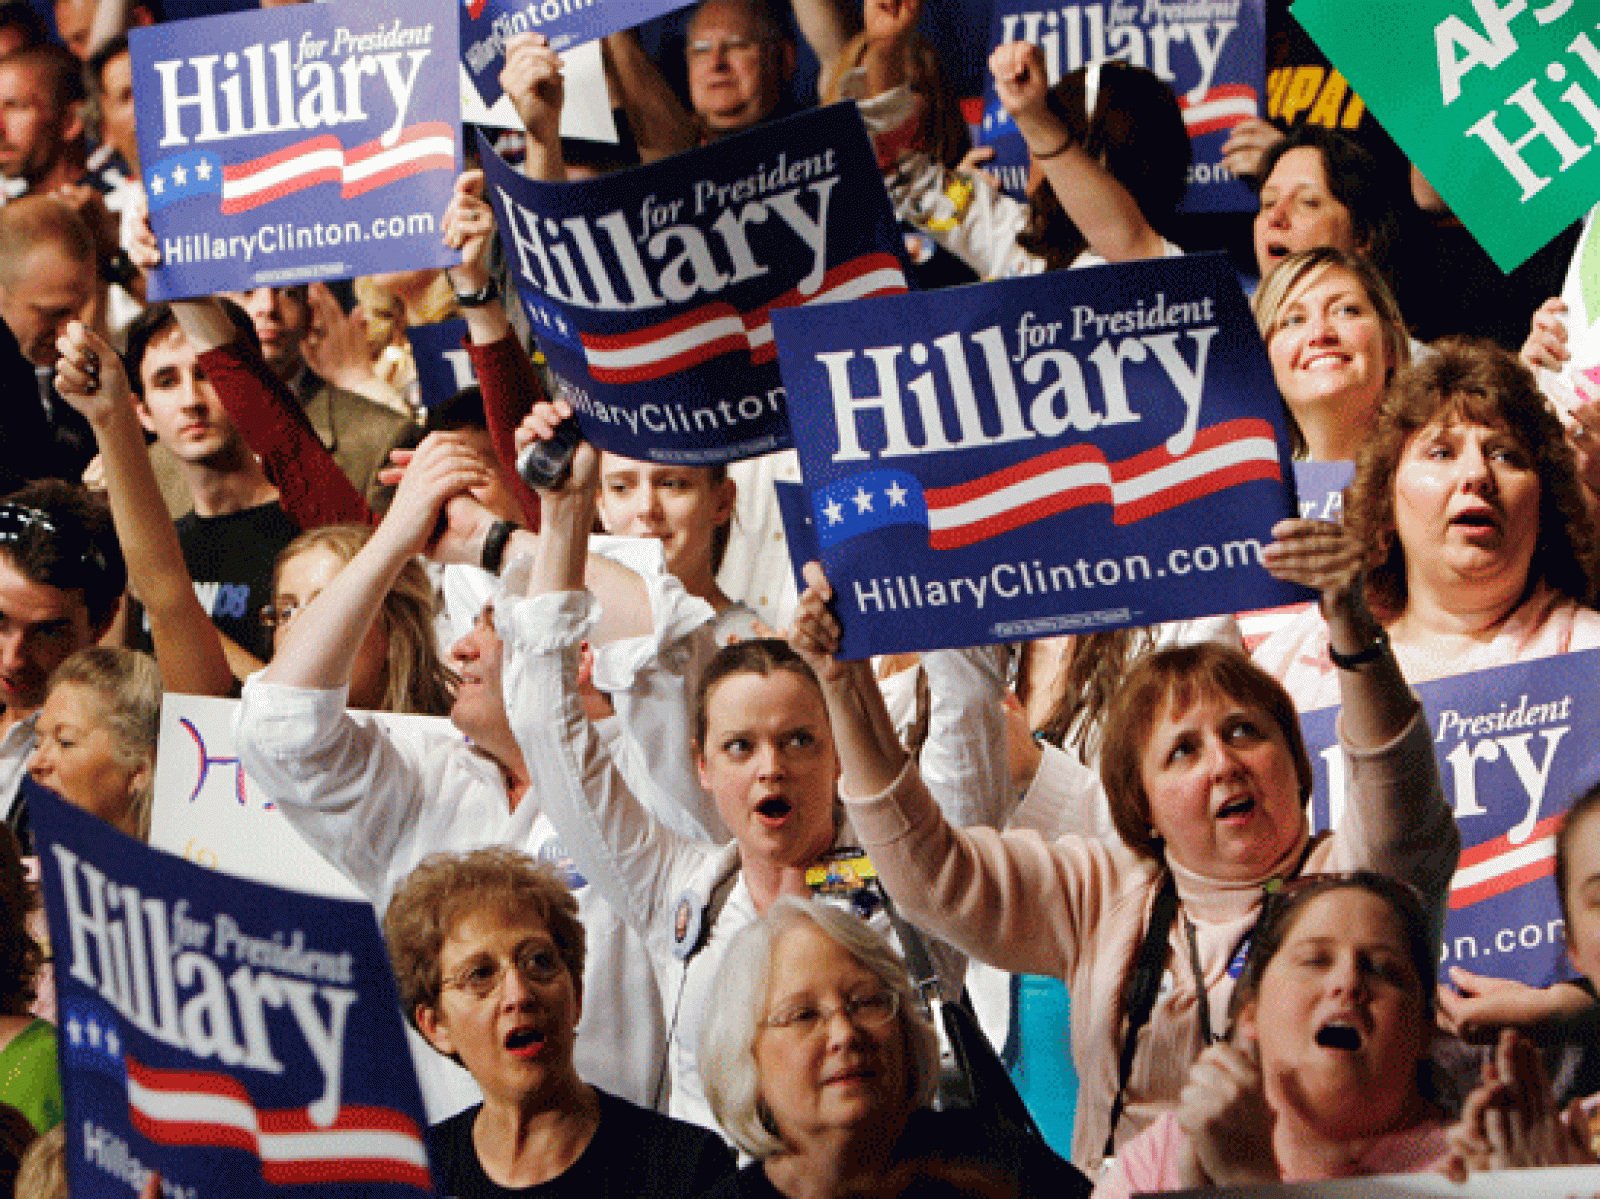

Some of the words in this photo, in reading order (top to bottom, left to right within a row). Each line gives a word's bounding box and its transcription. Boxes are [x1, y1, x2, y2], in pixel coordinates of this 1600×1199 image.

[292, 30, 329, 71] for
[332, 19, 434, 56] President
[153, 40, 431, 148] Hillary
[636, 195, 683, 242] for
[693, 149, 836, 216] President
[164, 212, 434, 266] HillaryClinton.com
[495, 177, 841, 312] Hillary
[1012, 311, 1062, 362] for
[1071, 293, 1214, 340] President
[814, 325, 1220, 462] Hillary
[852, 538, 1264, 613] HillaryClinton.com
[1434, 694, 1572, 743] President
[171, 899, 211, 955] for
[215, 913, 352, 983] President
[52, 843, 358, 1128] Hillary
